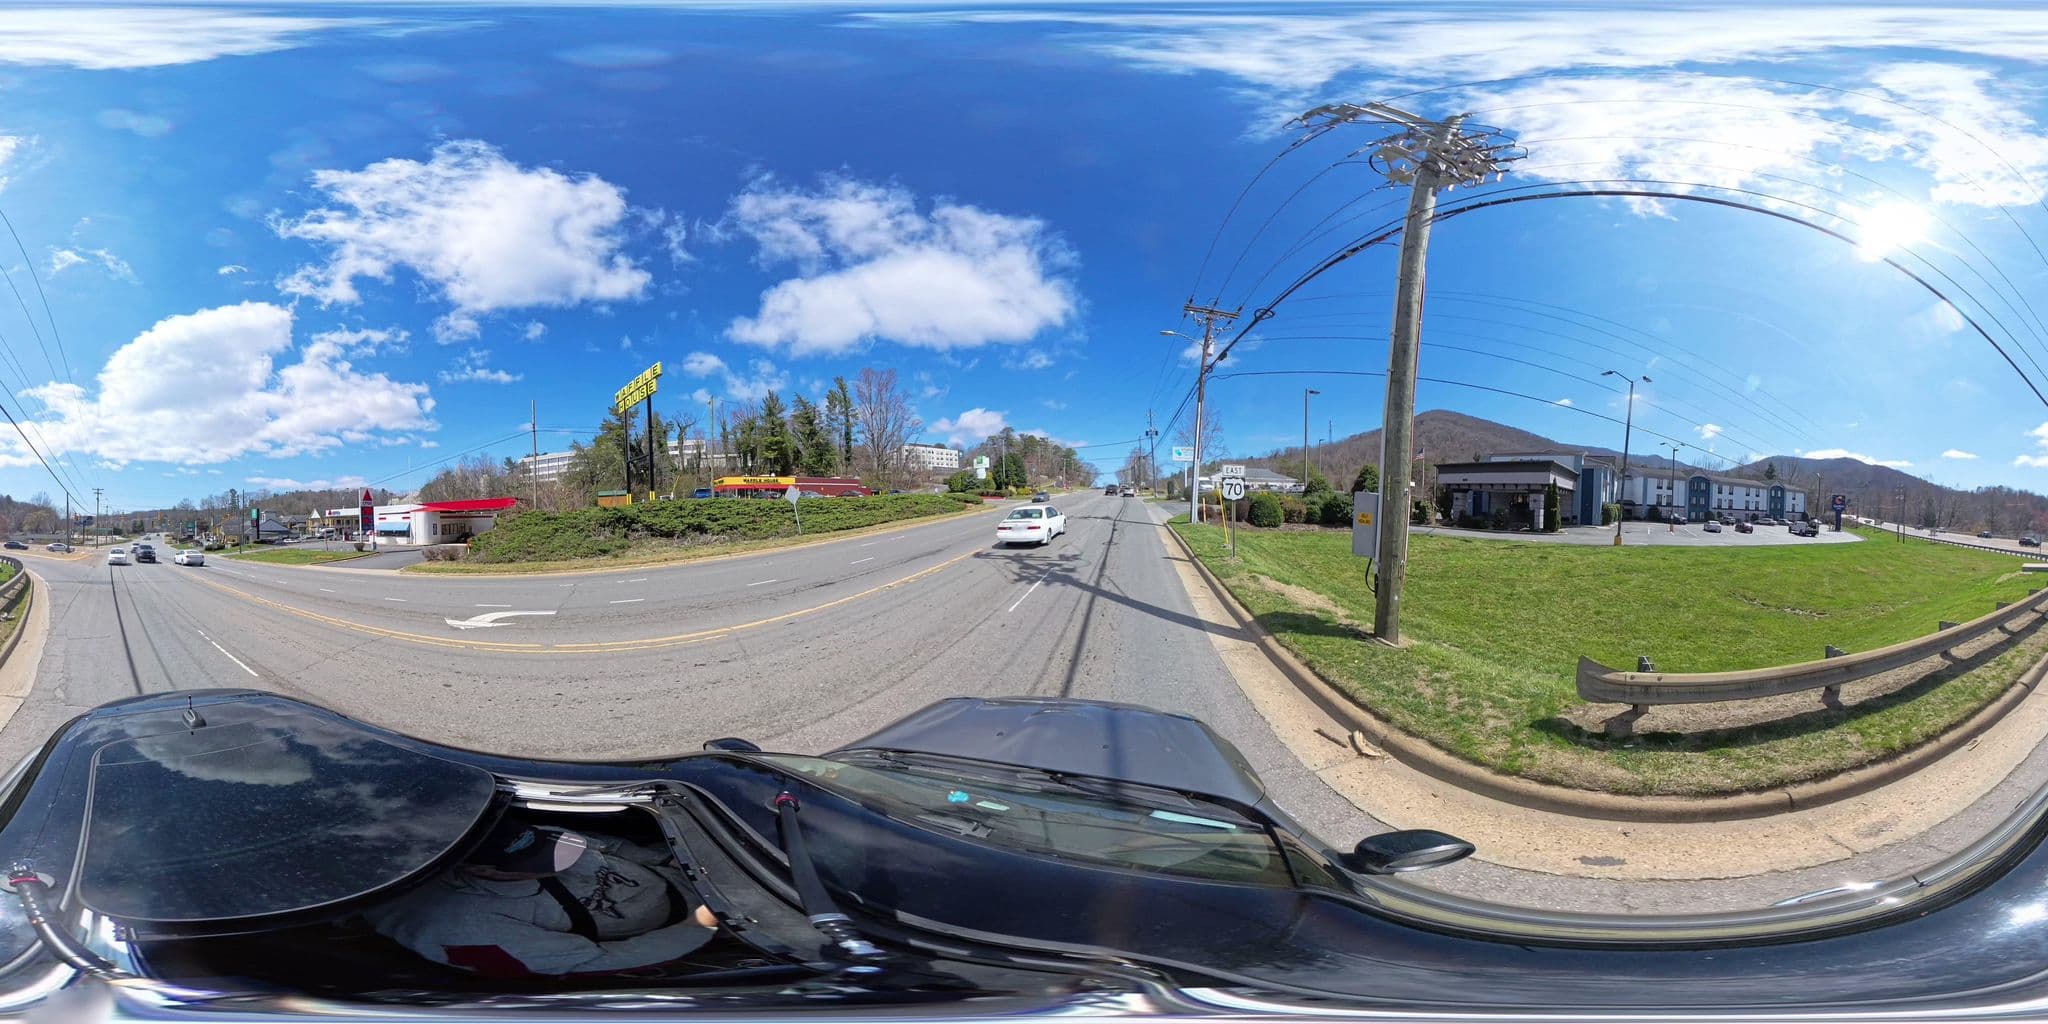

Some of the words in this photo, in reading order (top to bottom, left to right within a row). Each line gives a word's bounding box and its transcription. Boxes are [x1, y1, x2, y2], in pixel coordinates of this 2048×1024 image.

[616, 365, 658, 401] WAFFLE
[620, 381, 655, 412] HOUSE
[1225, 466, 1242, 474] EAST
[1225, 483, 1243, 496] 70
